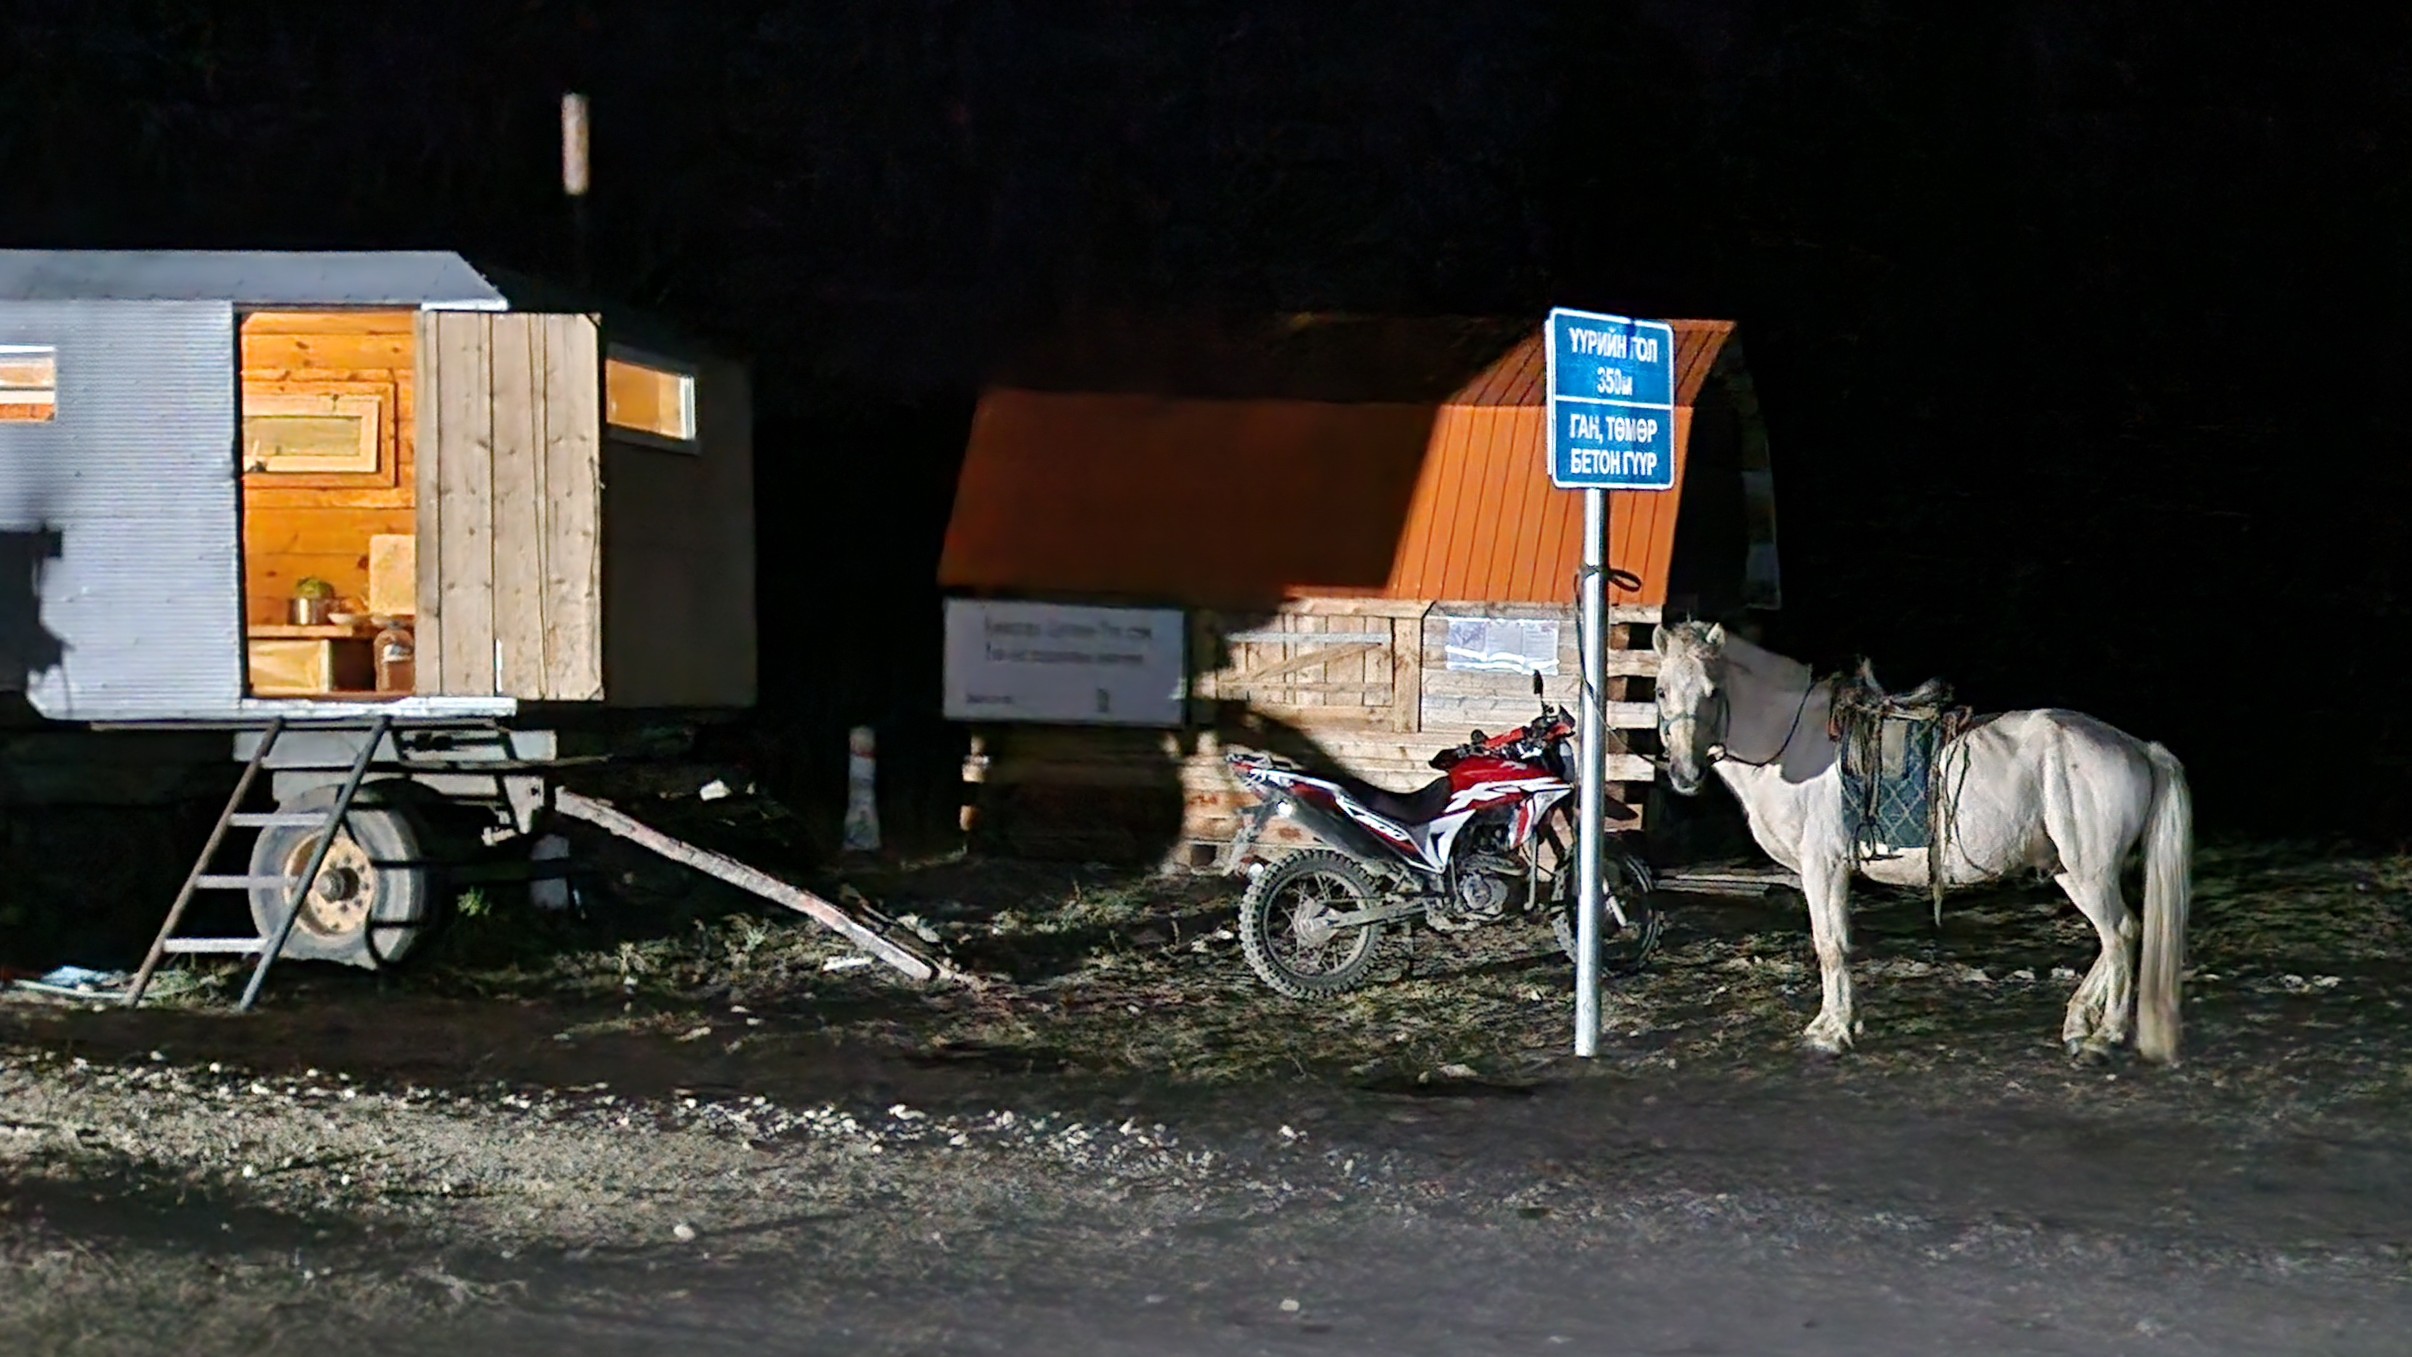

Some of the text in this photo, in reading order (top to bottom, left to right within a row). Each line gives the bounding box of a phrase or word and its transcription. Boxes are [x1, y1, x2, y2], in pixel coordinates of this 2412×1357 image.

[1630, 336, 1658, 363] ГОЛ
[1569, 414, 1658, 444] ГАН, ТӨМӨР
[1570, 448, 1658, 476] БЕТОН ГҮҮР
